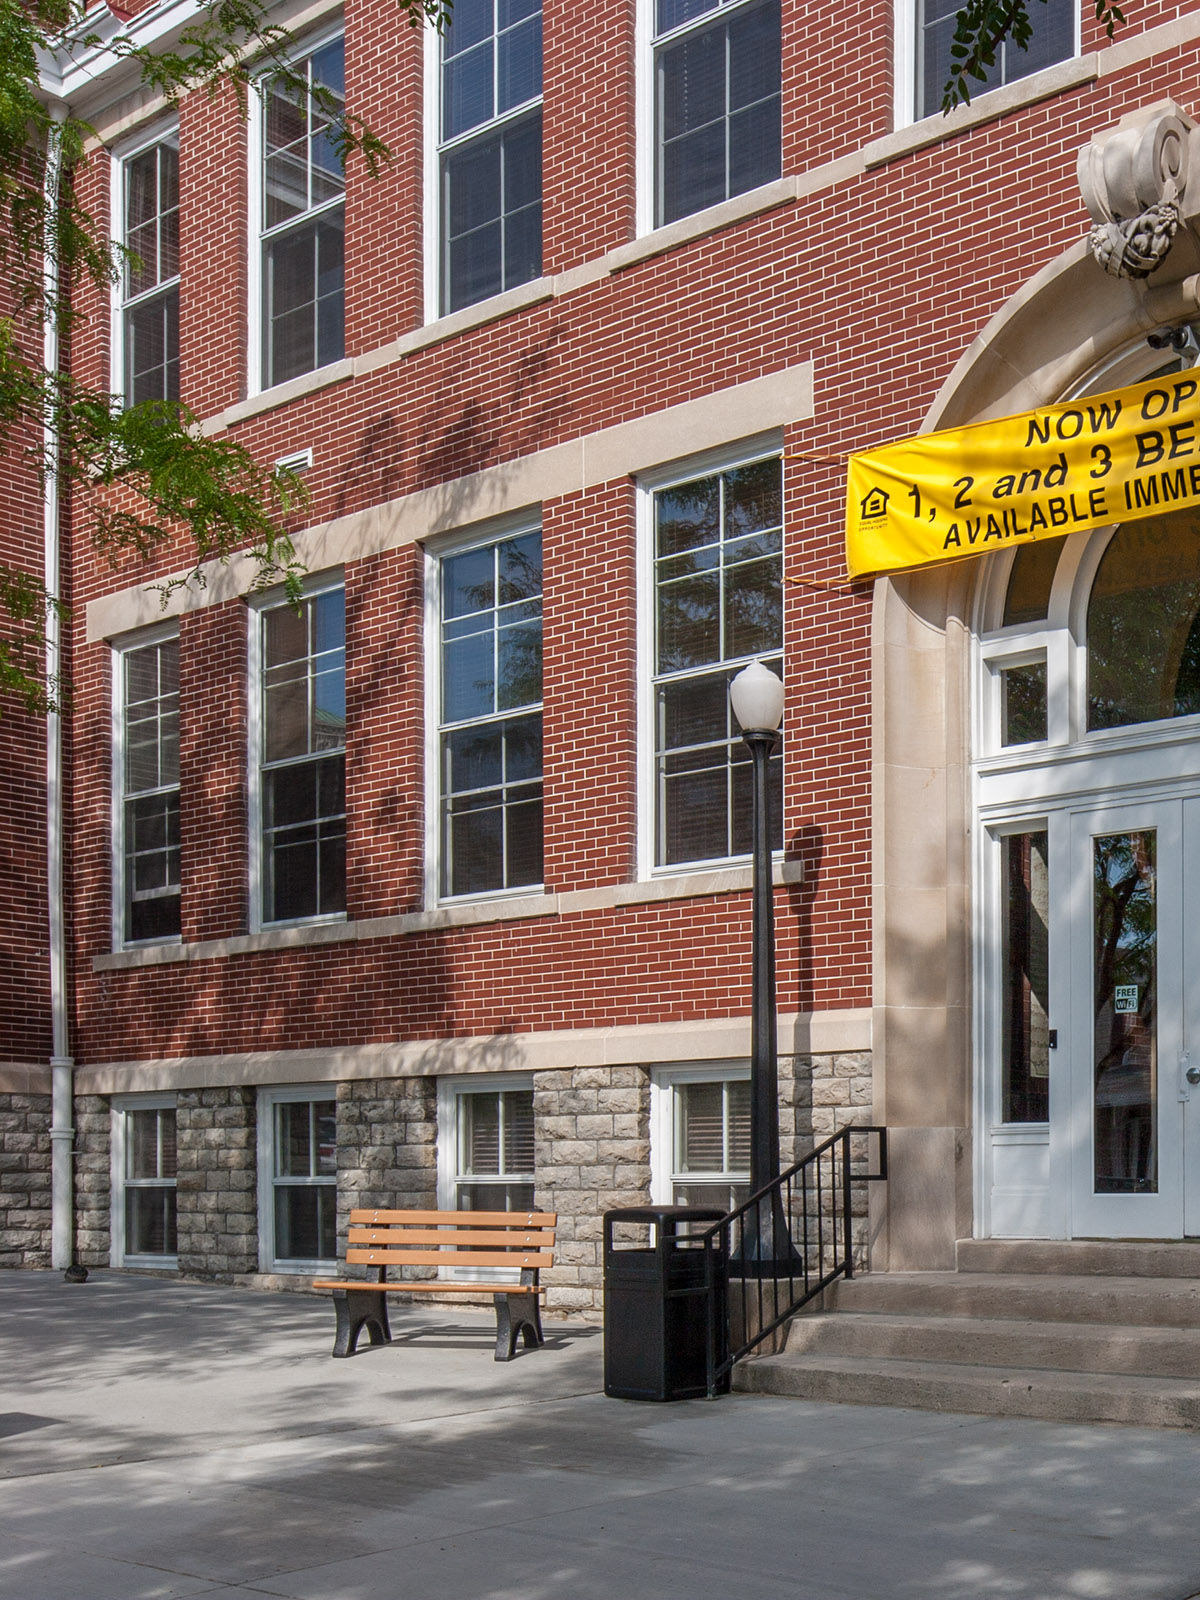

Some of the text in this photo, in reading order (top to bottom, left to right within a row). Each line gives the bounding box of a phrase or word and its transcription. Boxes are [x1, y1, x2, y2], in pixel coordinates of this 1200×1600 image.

[1025, 399, 1123, 447] NOW
[908, 484, 936, 523] 1,
[952, 476, 974, 509] 2
[992, 453, 1068, 499] and
[1089, 444, 1113, 479] 3
[943, 487, 1109, 549] AVAILABLE
[1116, 988, 1136, 997] FREE
